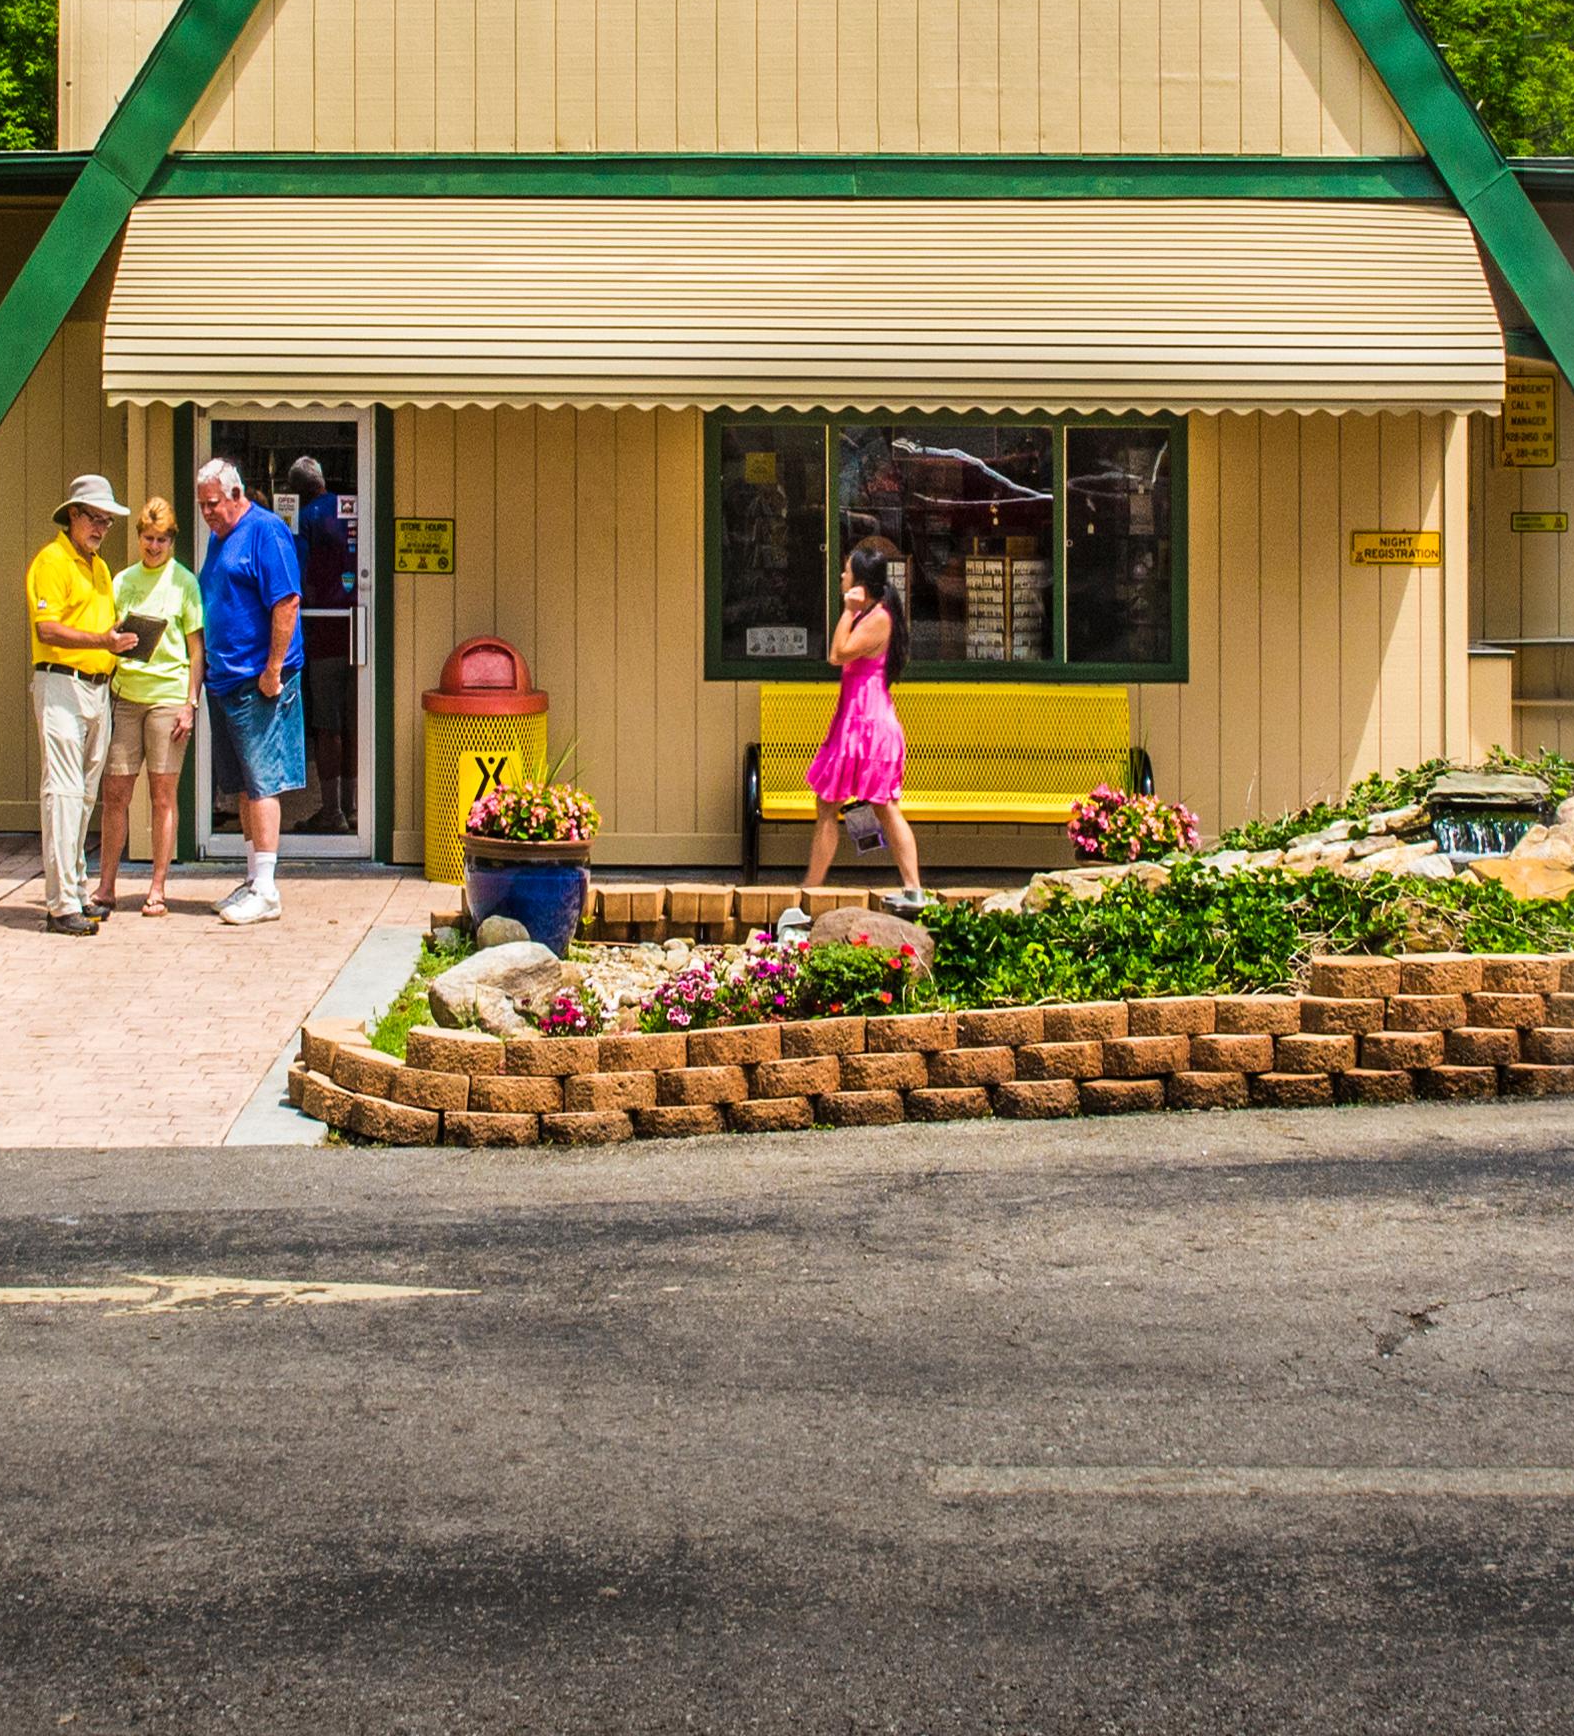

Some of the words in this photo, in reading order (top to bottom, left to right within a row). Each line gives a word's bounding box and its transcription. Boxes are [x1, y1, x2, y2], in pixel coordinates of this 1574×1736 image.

[1507, 384, 1550, 394] EMERGENCY
[1511, 400, 1531, 410] CALL
[1511, 416, 1547, 425] MANAGER
[425, 522, 448, 532] HOURS
[1379, 536, 1413, 547] NIGHT
[1364, 548, 1439, 559] REGISTRATION
